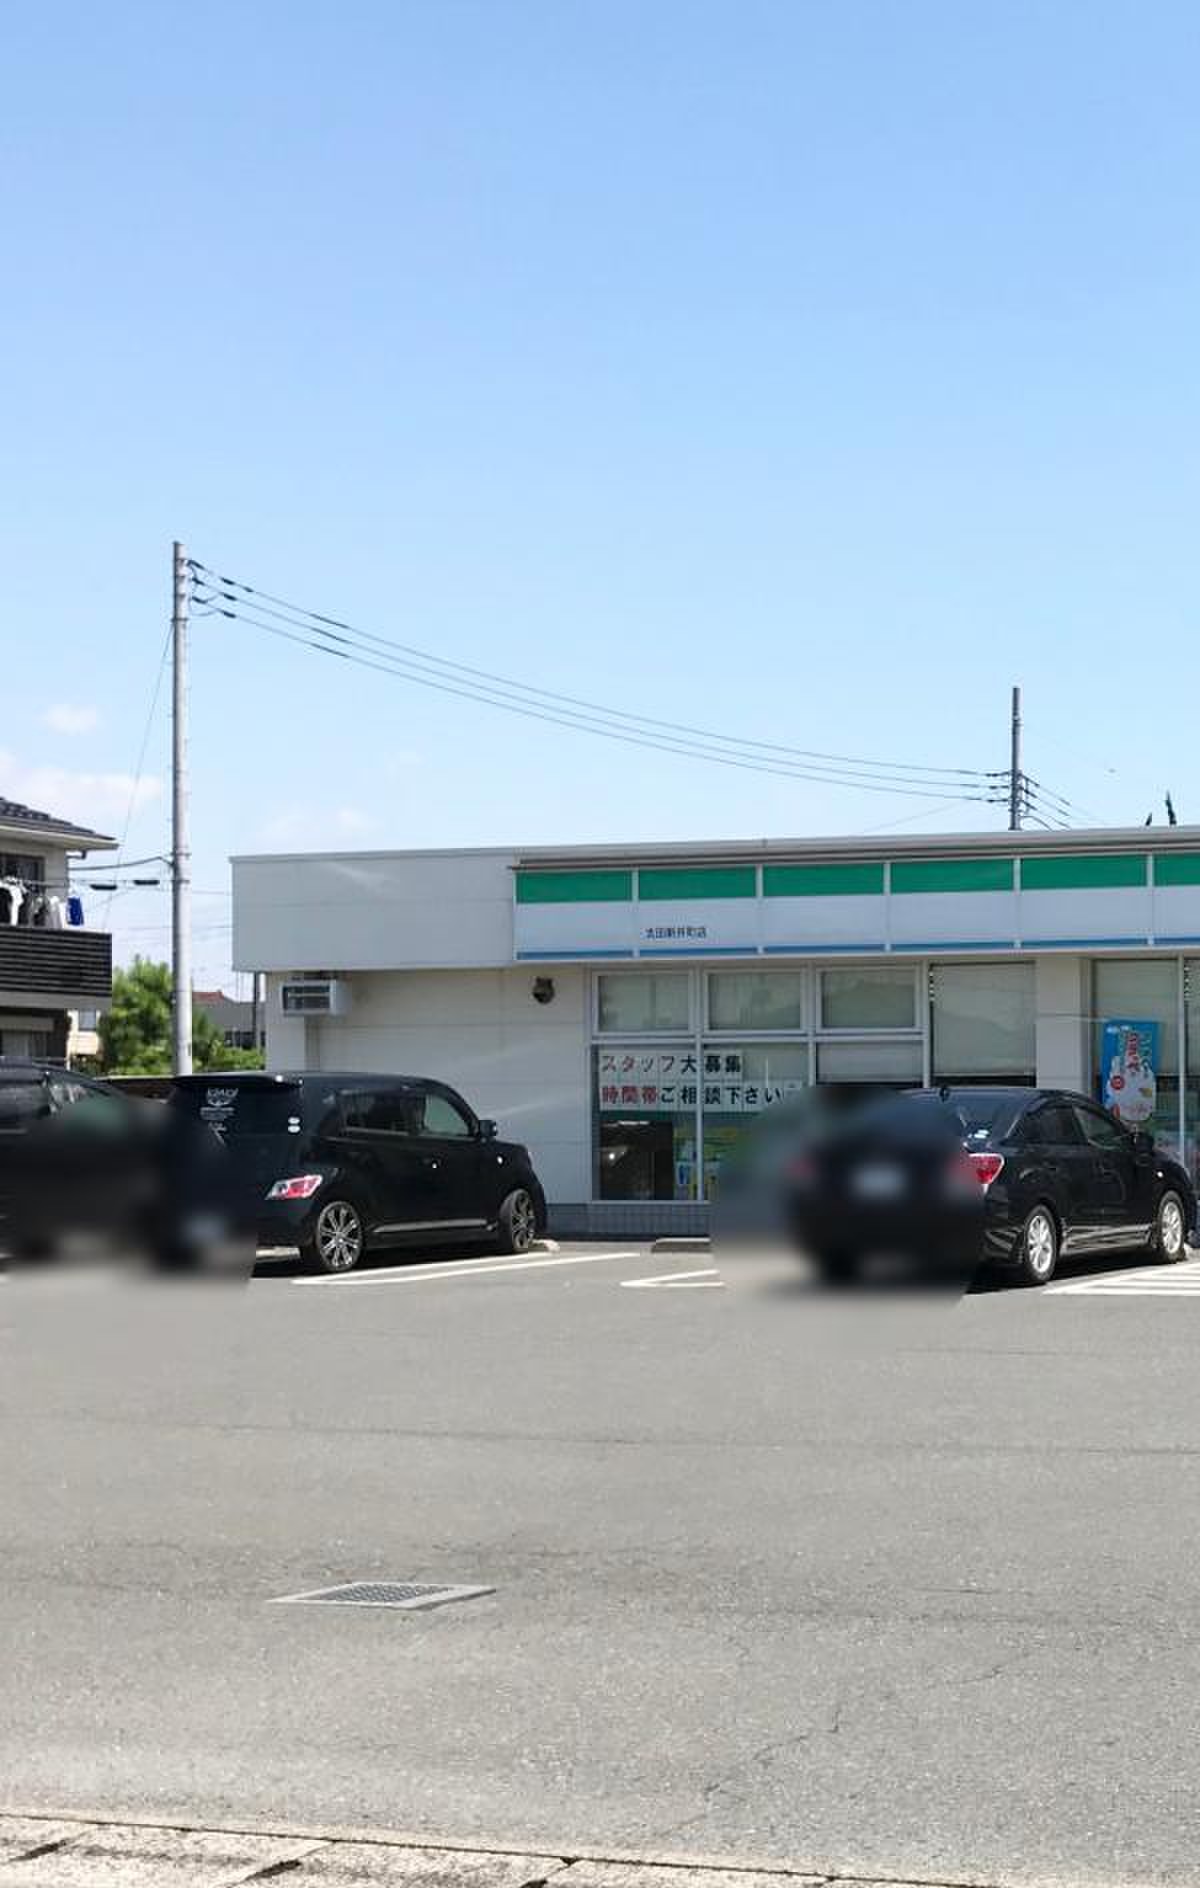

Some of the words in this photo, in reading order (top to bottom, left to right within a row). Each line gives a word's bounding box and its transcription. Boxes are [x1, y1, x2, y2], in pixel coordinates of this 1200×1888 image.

[601, 1055, 741, 1073] スタッフ大募集
